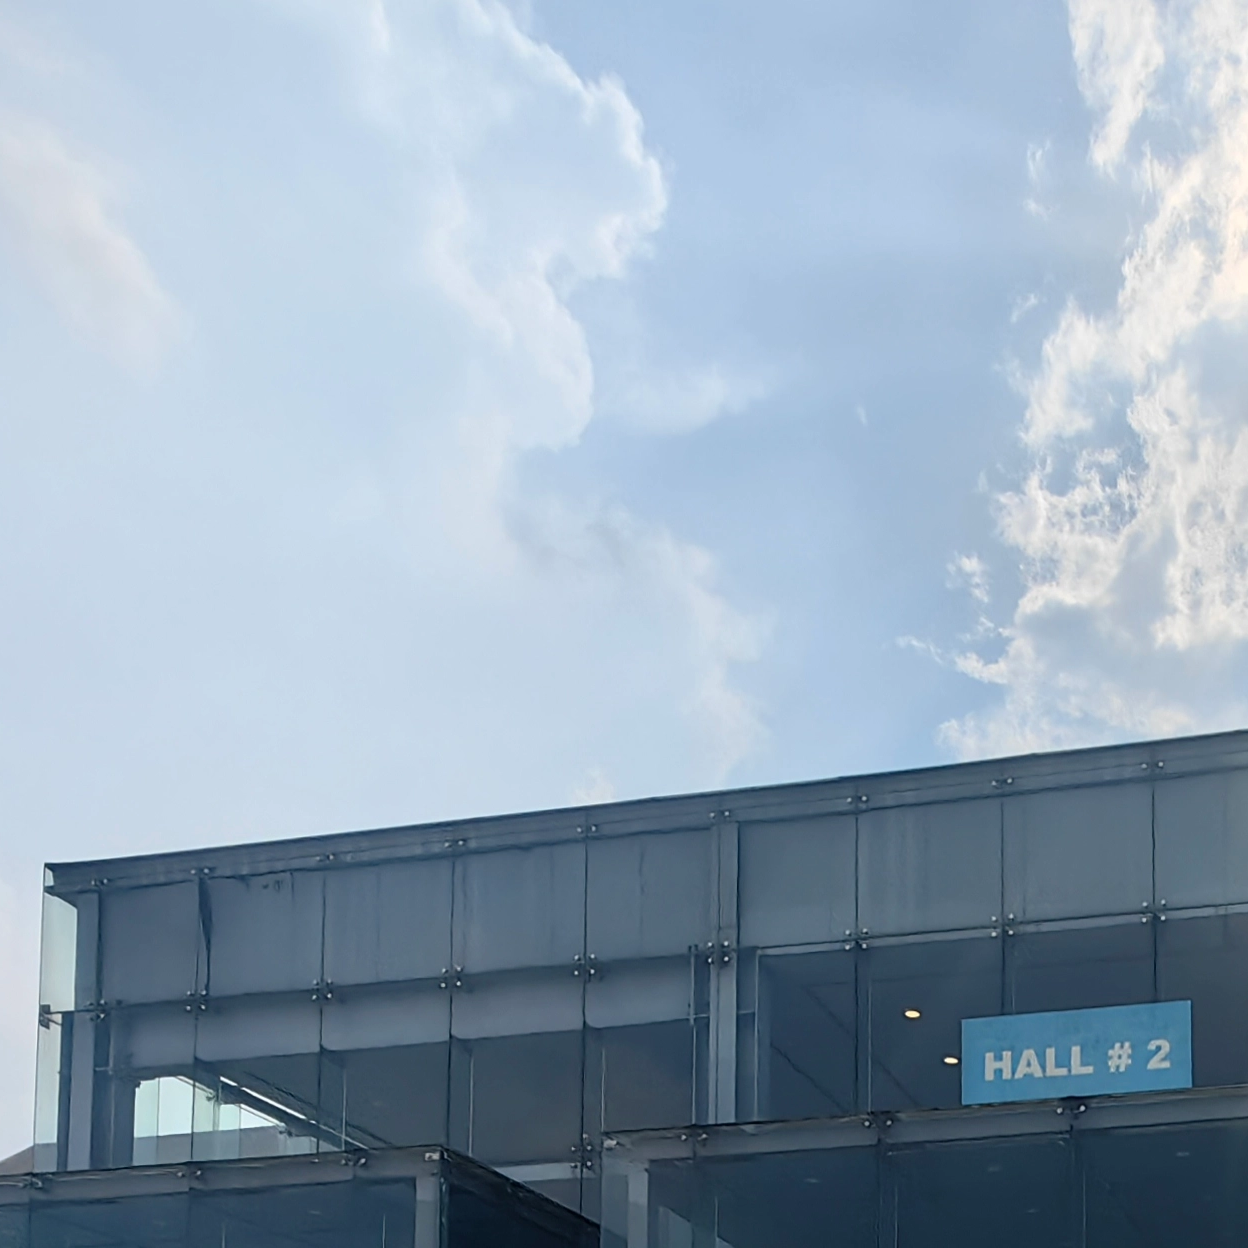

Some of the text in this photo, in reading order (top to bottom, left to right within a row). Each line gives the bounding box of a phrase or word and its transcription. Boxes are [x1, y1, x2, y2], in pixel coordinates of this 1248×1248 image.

[984, 1039, 1171, 1081] HALL # 2
